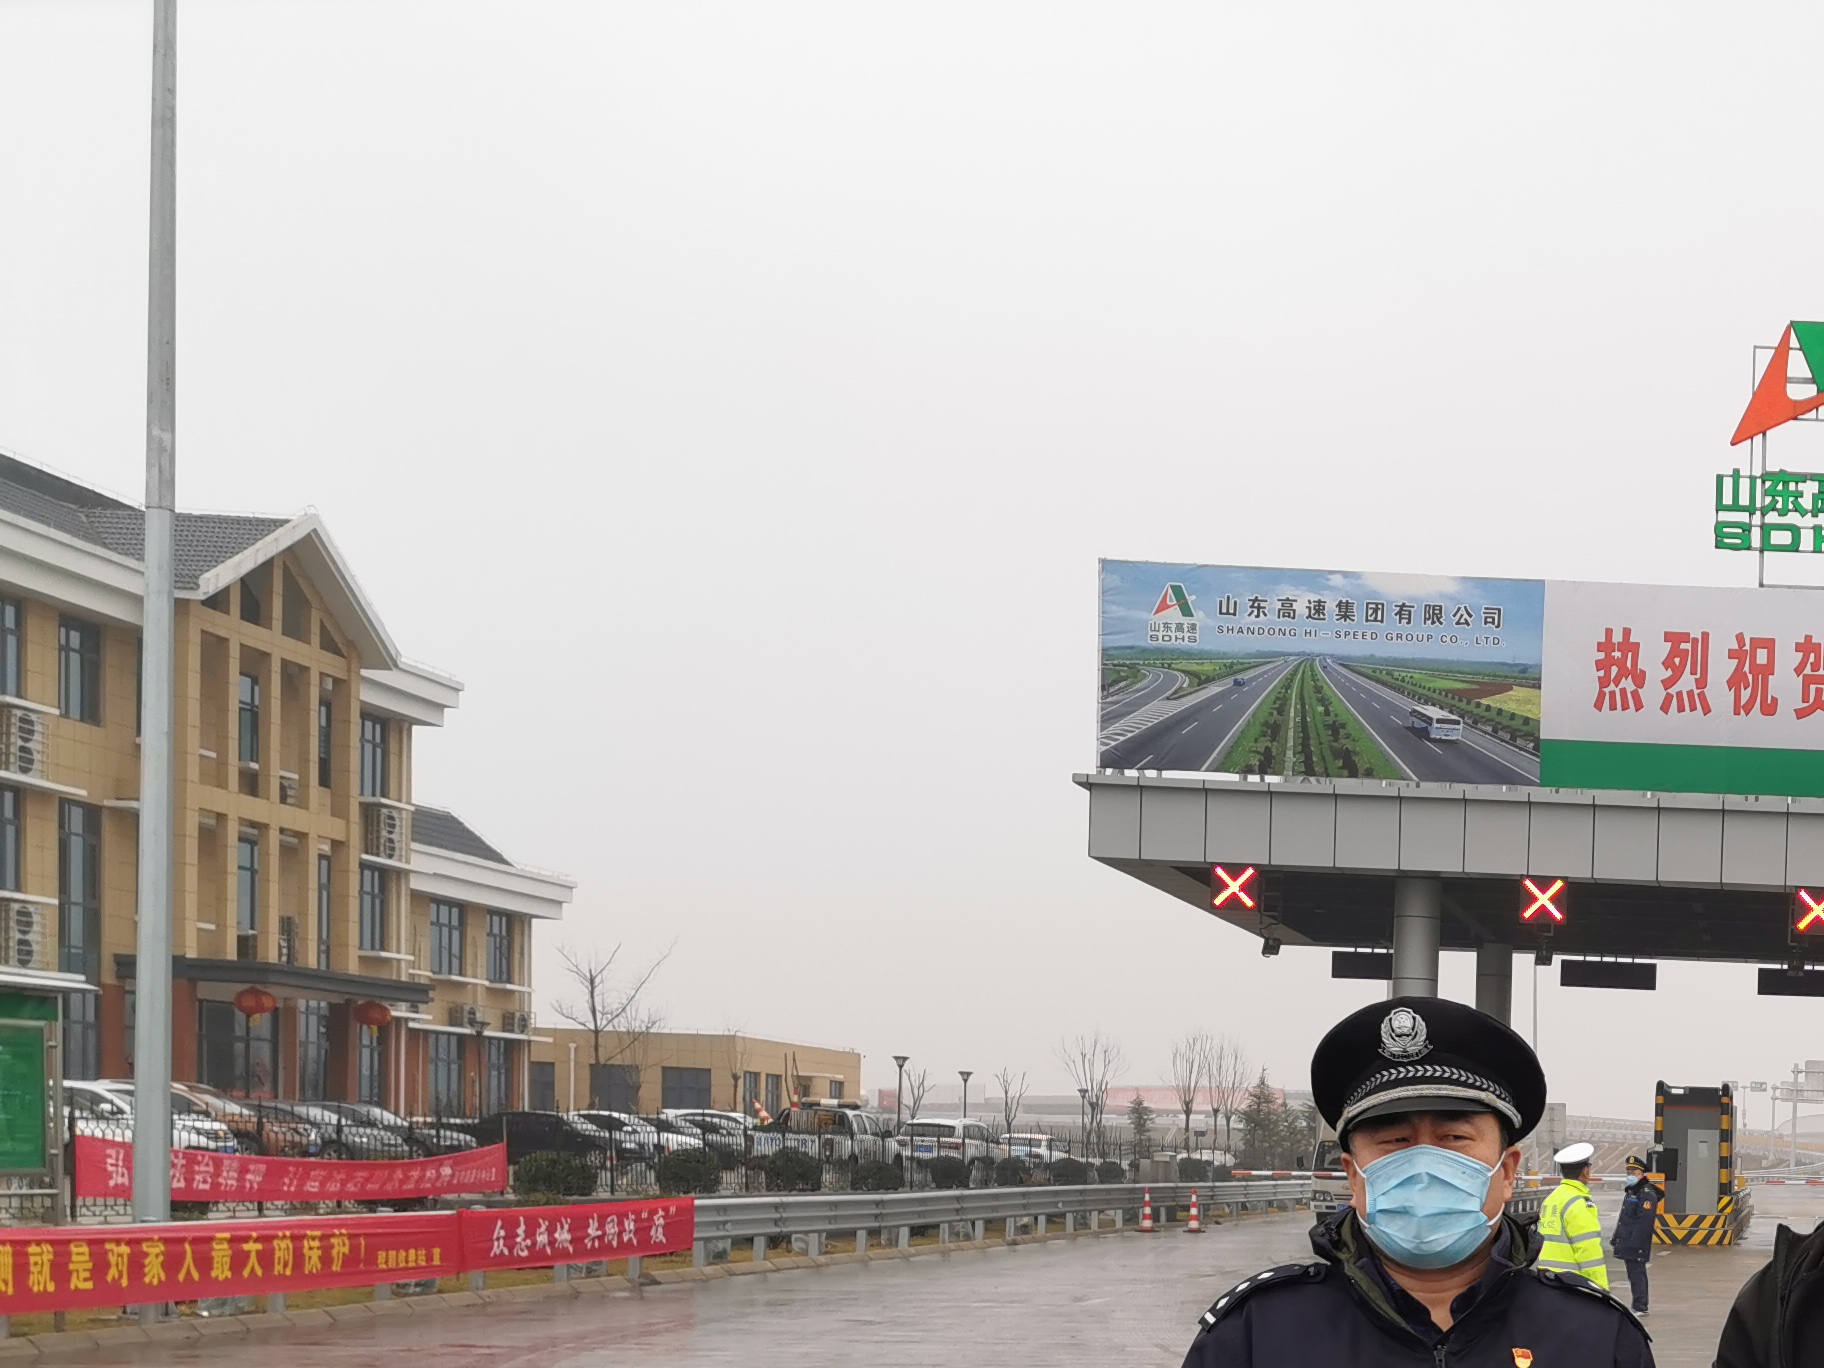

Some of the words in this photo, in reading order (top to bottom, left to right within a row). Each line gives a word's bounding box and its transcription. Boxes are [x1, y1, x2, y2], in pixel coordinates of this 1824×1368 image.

[1218, 594, 1504, 629] 山东高速集团有限公司
[1150, 621, 1197, 634] 山东高速
[1150, 634, 1197, 643] SDHS
[1216, 624, 1297, 638] SHANDONG
[1385, 632, 1434, 643] GROUP
[1440, 635, 1469, 646] CO.,
[1475, 636, 1506, 647] LTD.
[490, 1216, 573, 1257] 众志成城
